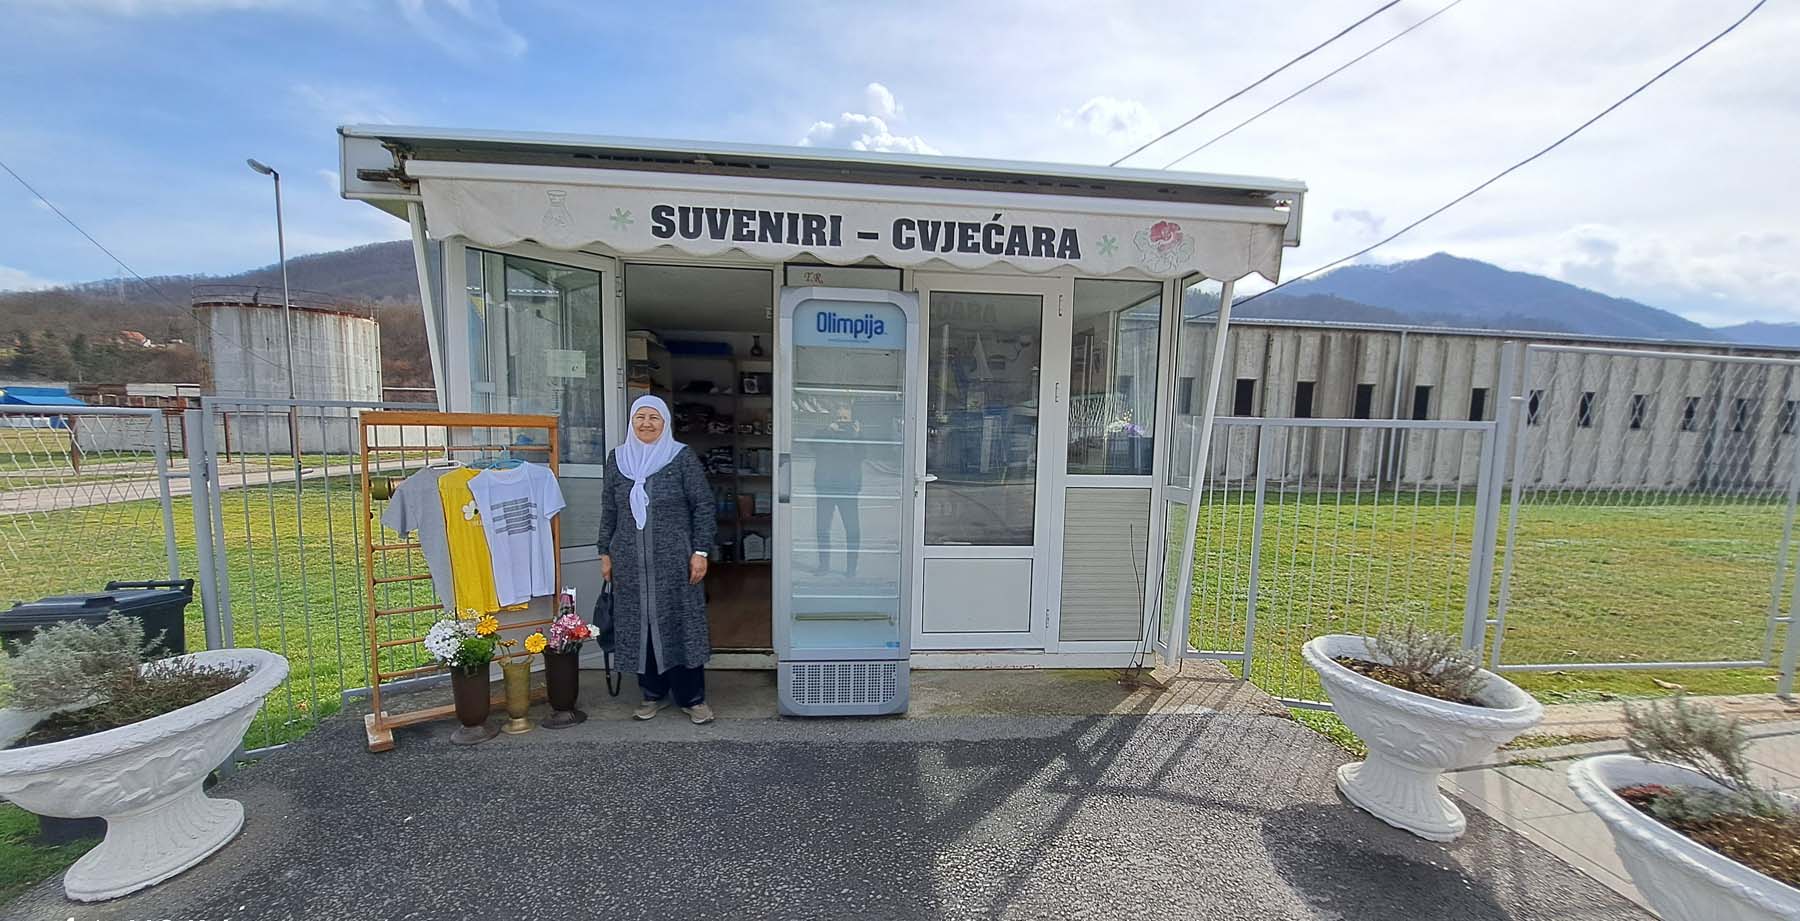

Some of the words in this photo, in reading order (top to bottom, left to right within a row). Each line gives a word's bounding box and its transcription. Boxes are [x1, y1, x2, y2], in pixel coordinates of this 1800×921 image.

[651, 205, 842, 247] SUVENIRI
[892, 213, 1081, 260] CVJEĆARA
[816, 311, 885, 339] Olimpija
